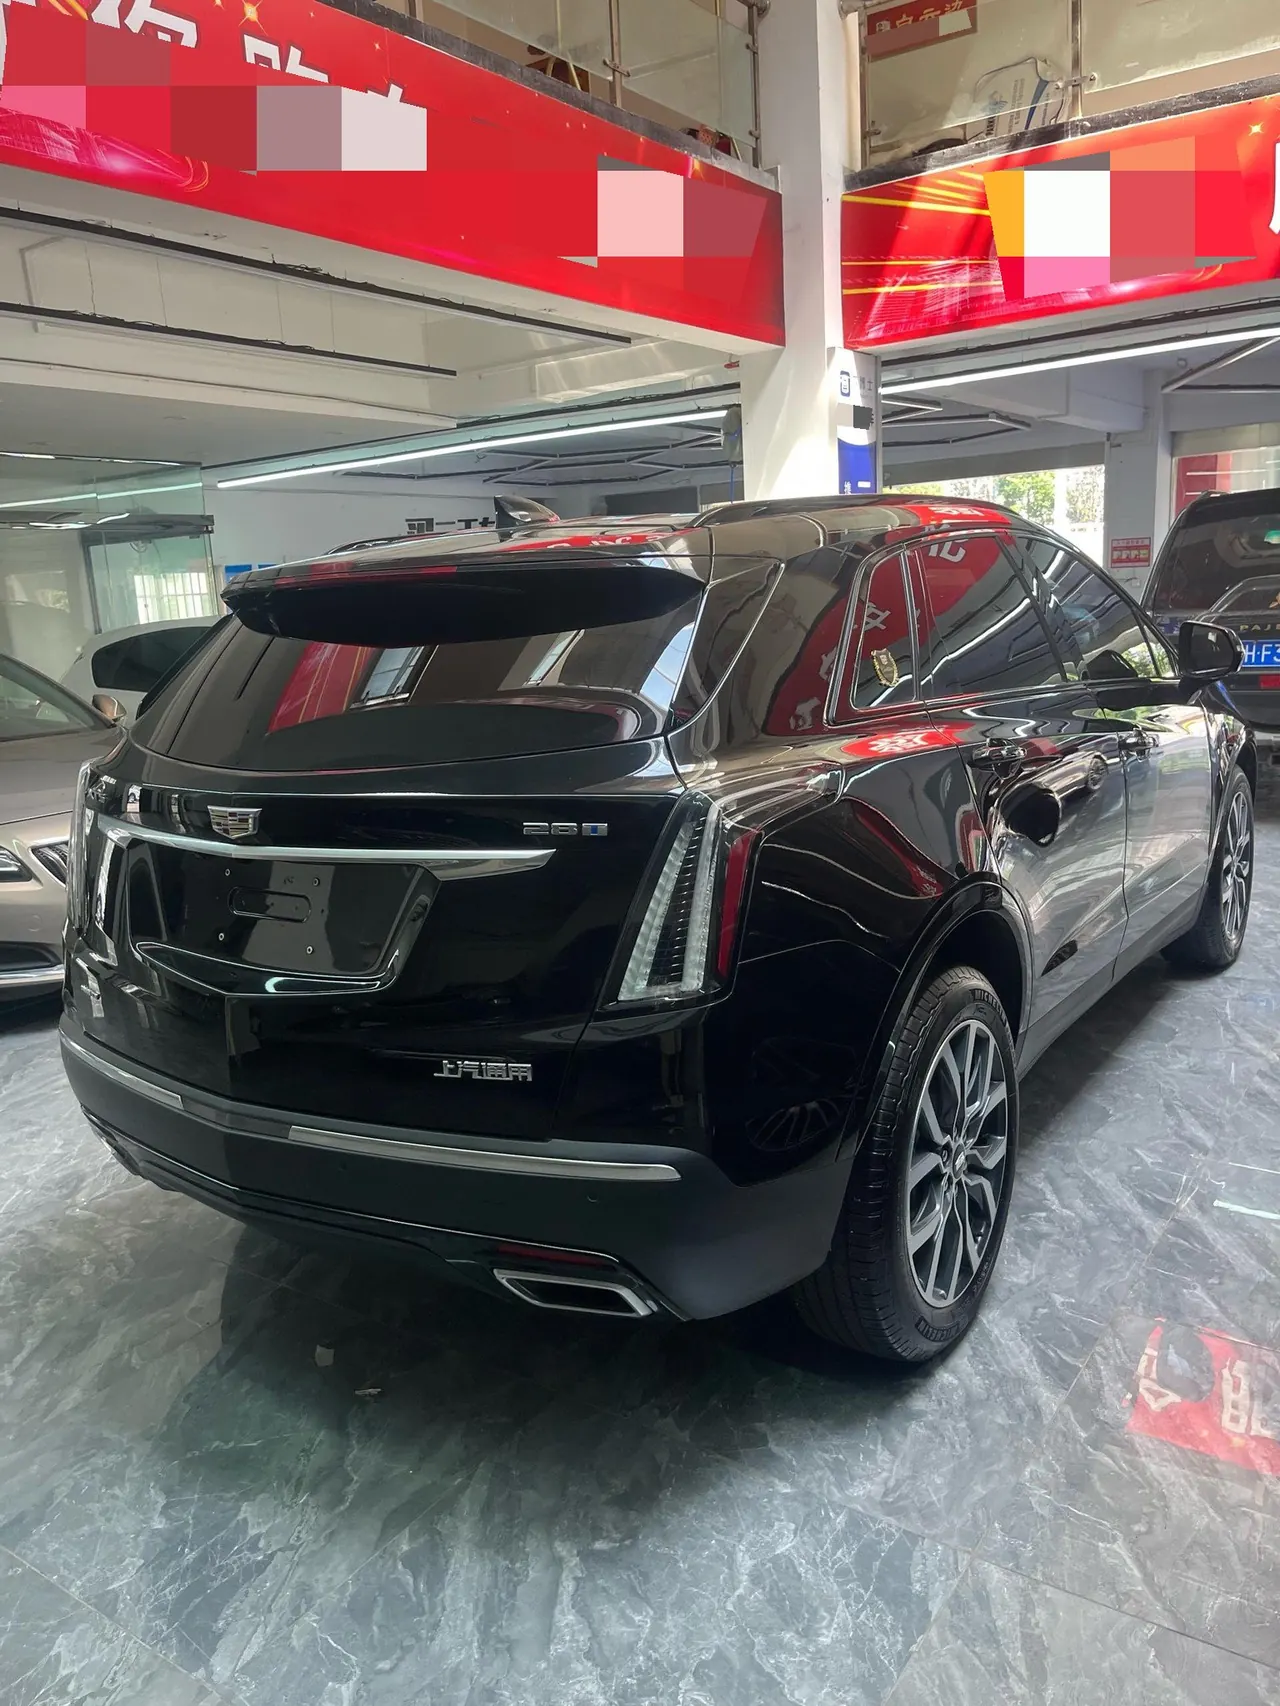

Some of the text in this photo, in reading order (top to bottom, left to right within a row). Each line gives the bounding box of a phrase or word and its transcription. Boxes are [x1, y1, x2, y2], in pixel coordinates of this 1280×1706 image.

[522, 822, 608, 836] 28T
[433, 1060, 533, 1082] 上汽通用
